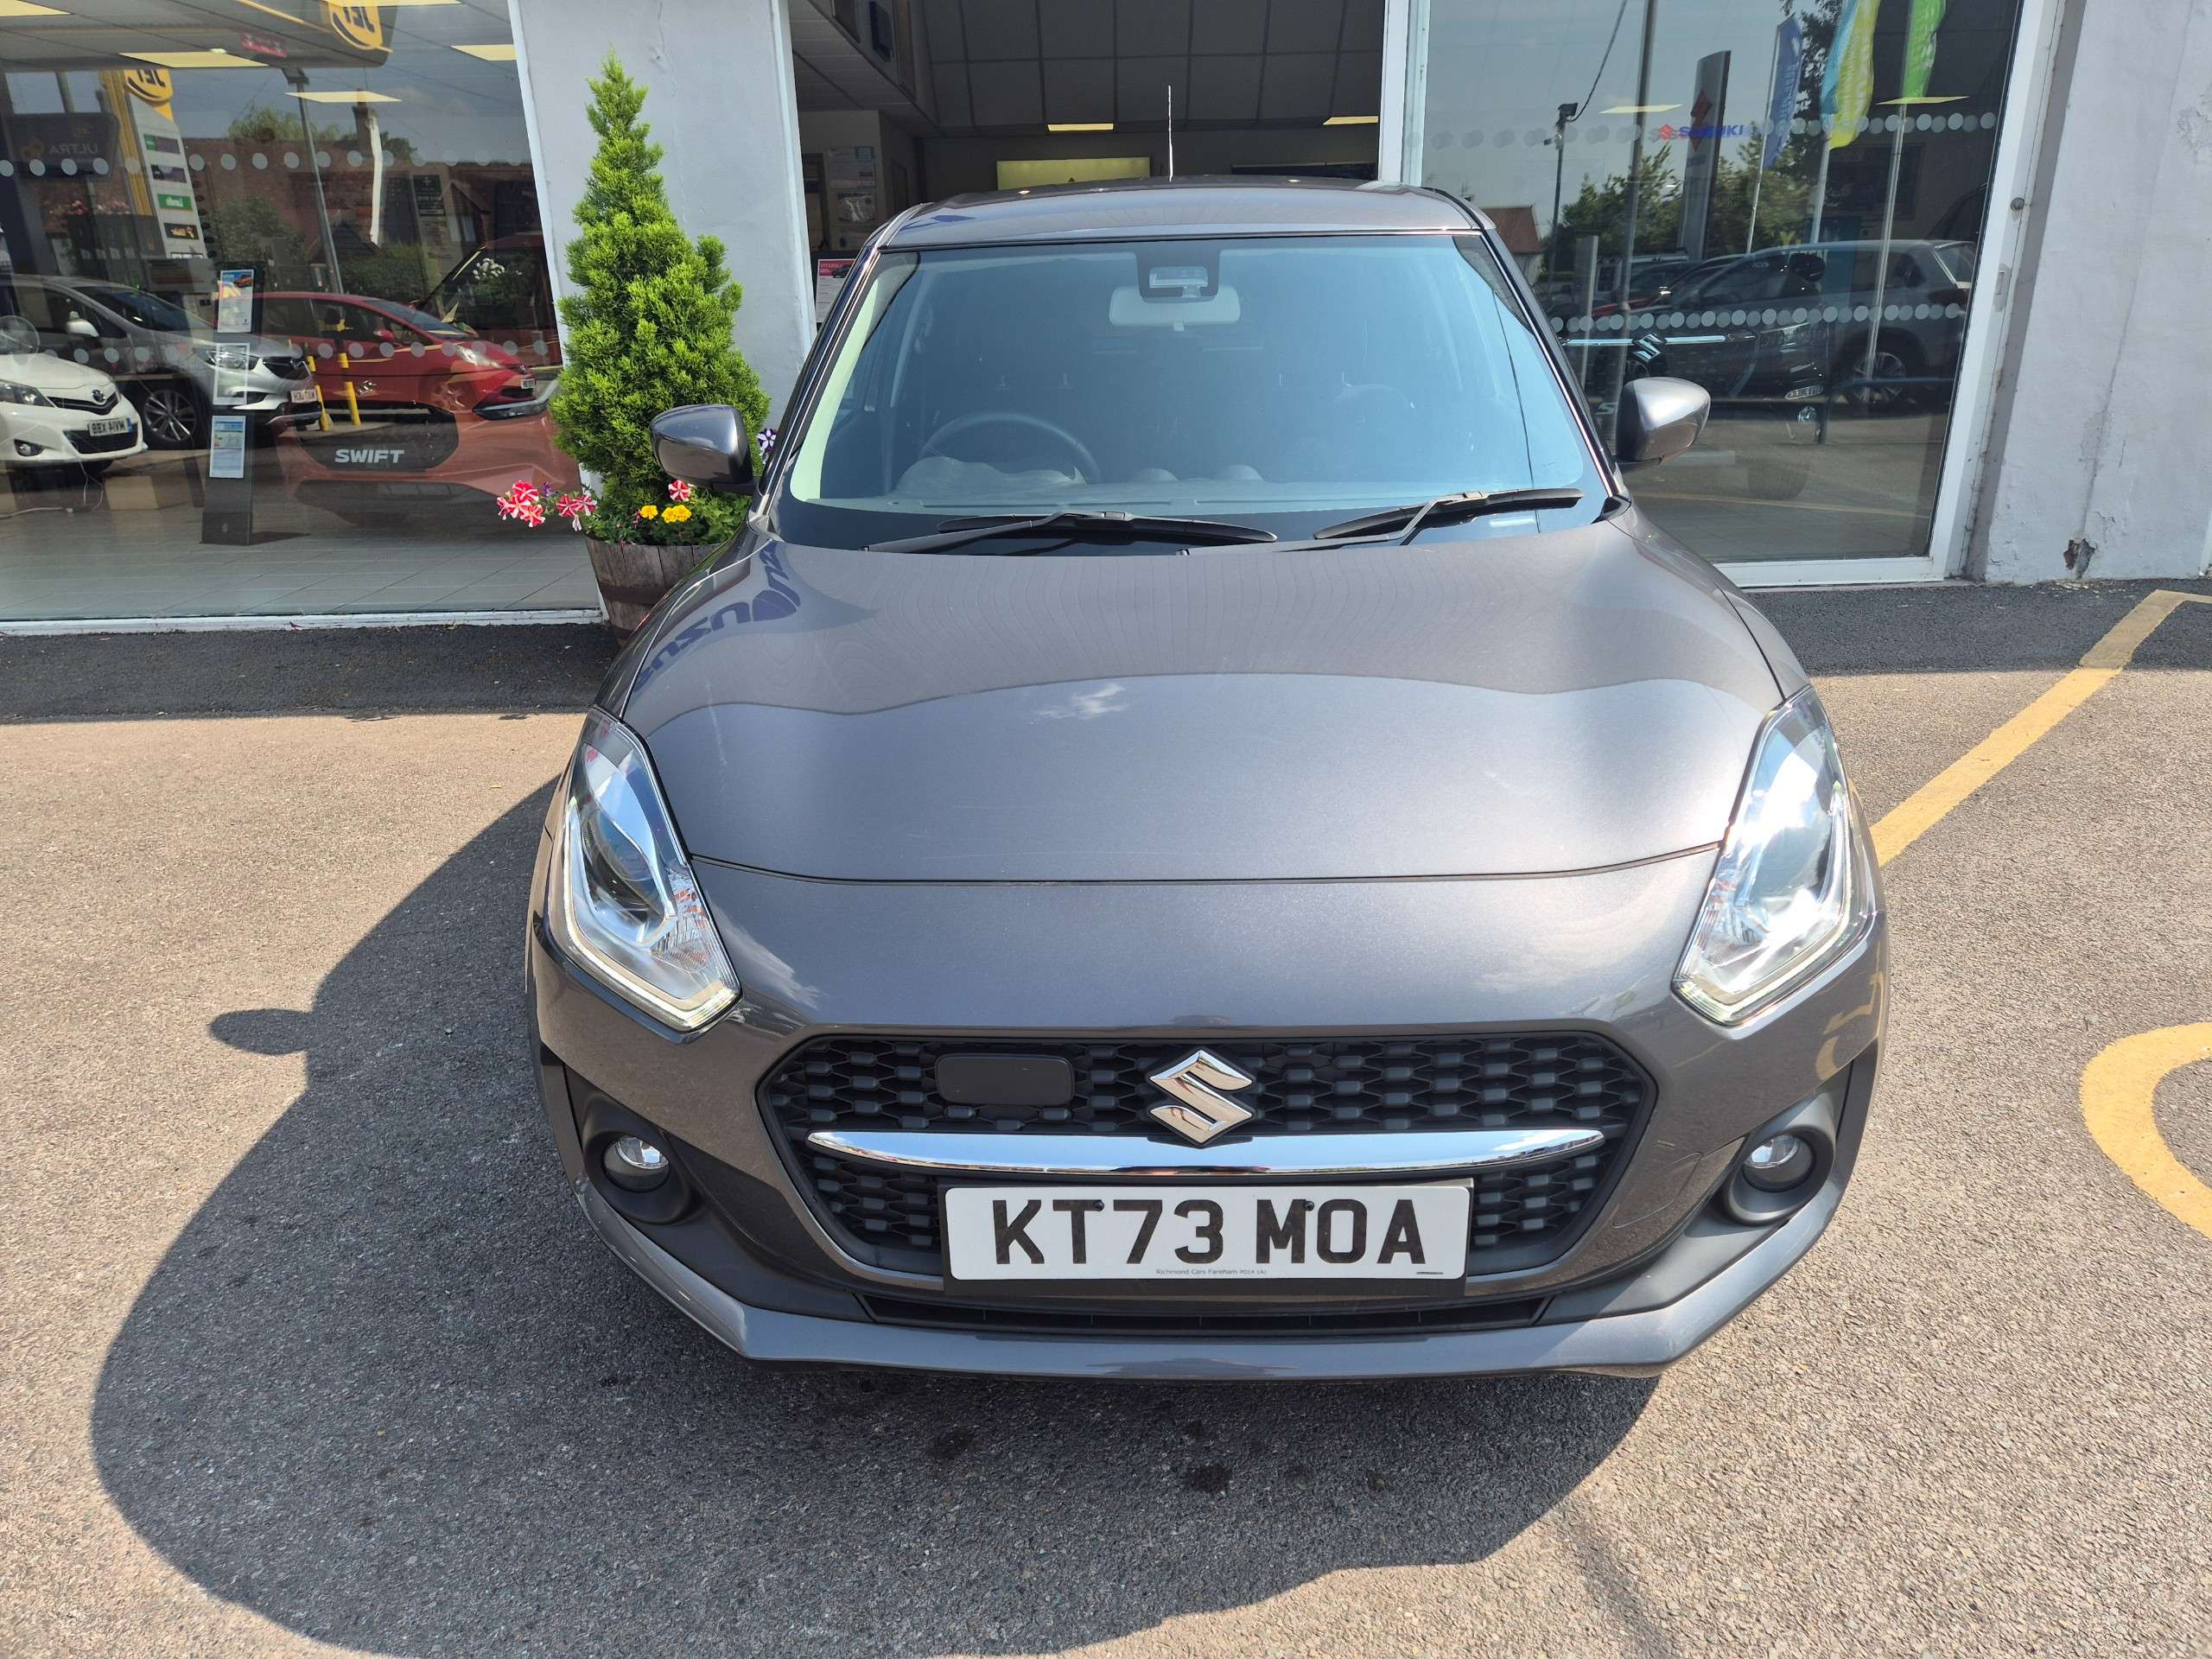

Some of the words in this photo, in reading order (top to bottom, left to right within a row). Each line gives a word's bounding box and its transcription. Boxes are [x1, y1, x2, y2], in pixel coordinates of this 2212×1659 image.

[334, 448, 405, 464] SWIFT
[991, 1198, 1224, 1264] KT73
[1255, 1198, 1427, 1264] MOA
